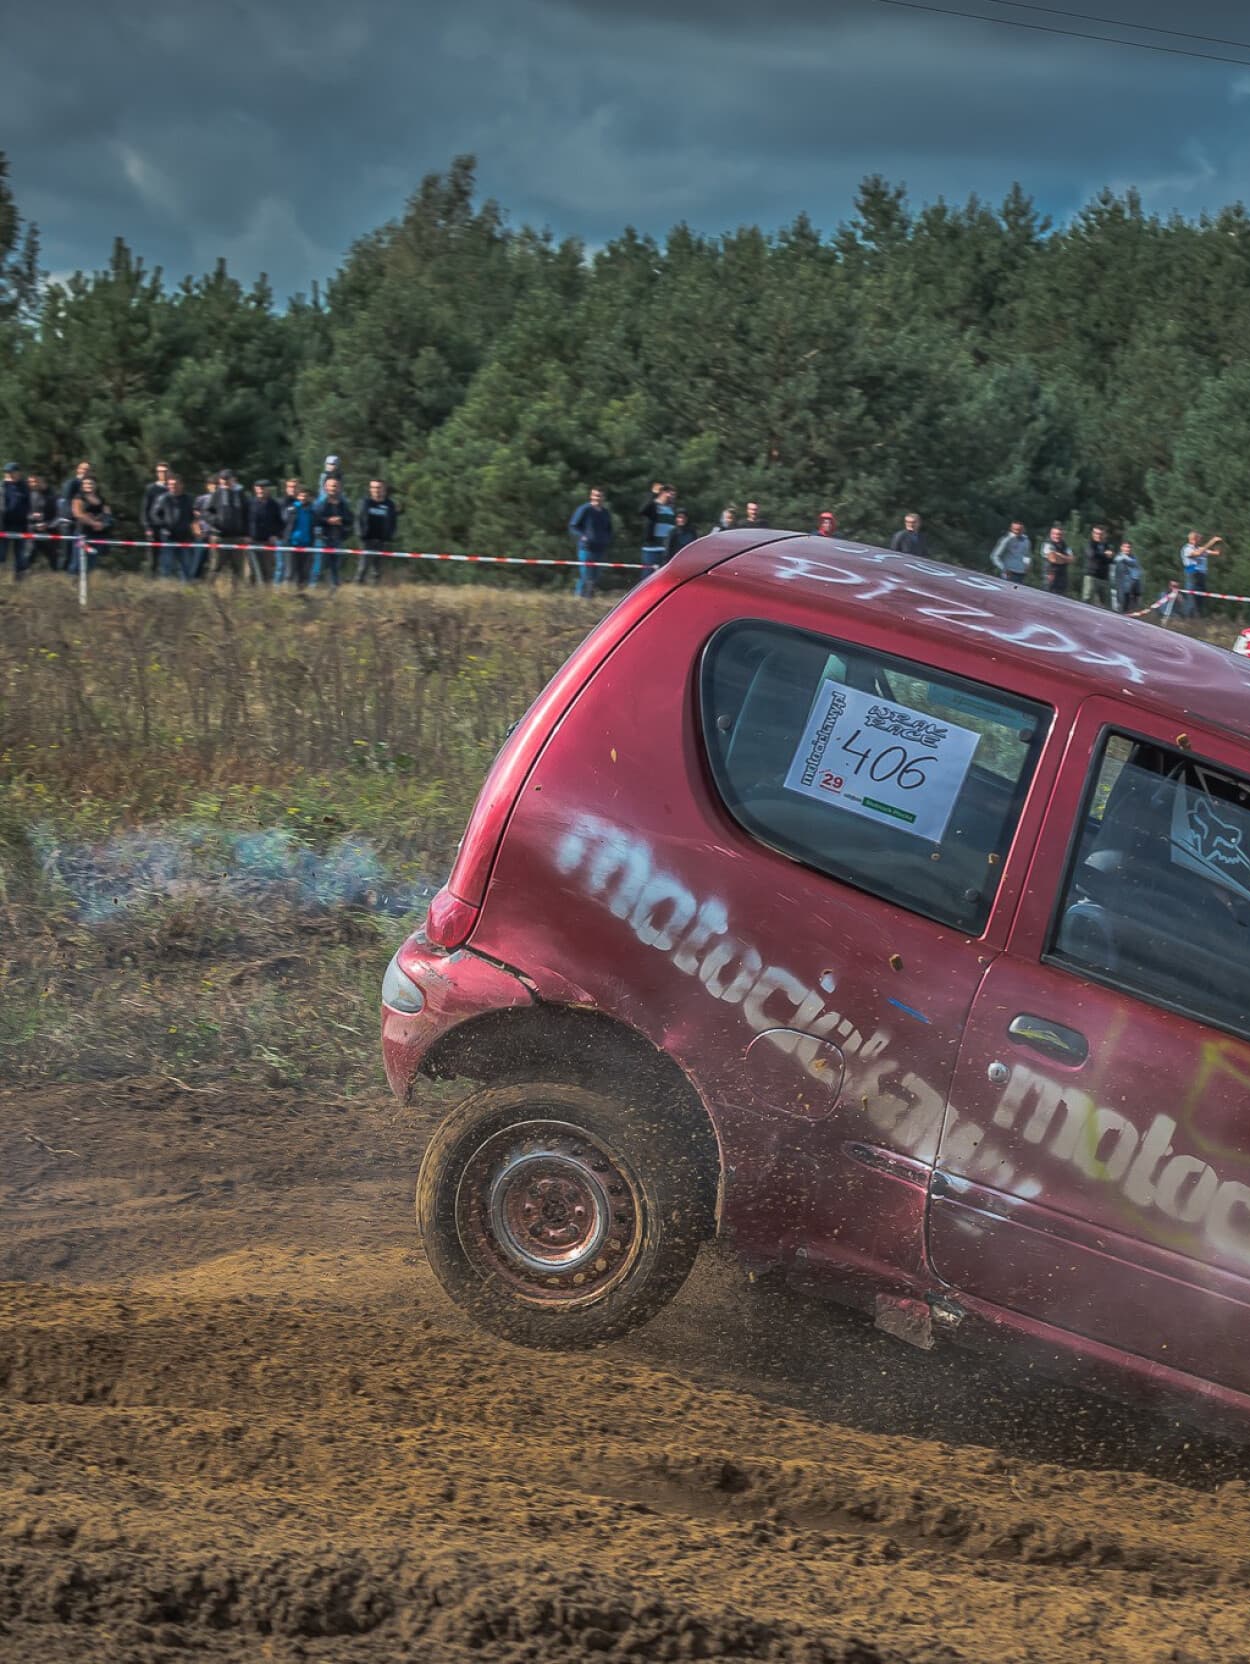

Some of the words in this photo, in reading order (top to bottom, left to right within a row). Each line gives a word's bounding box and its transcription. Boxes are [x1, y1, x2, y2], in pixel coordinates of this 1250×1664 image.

[863, 715, 941, 749] RACE
[842, 729, 938, 790] 406
[821, 771, 844, 790] 29
